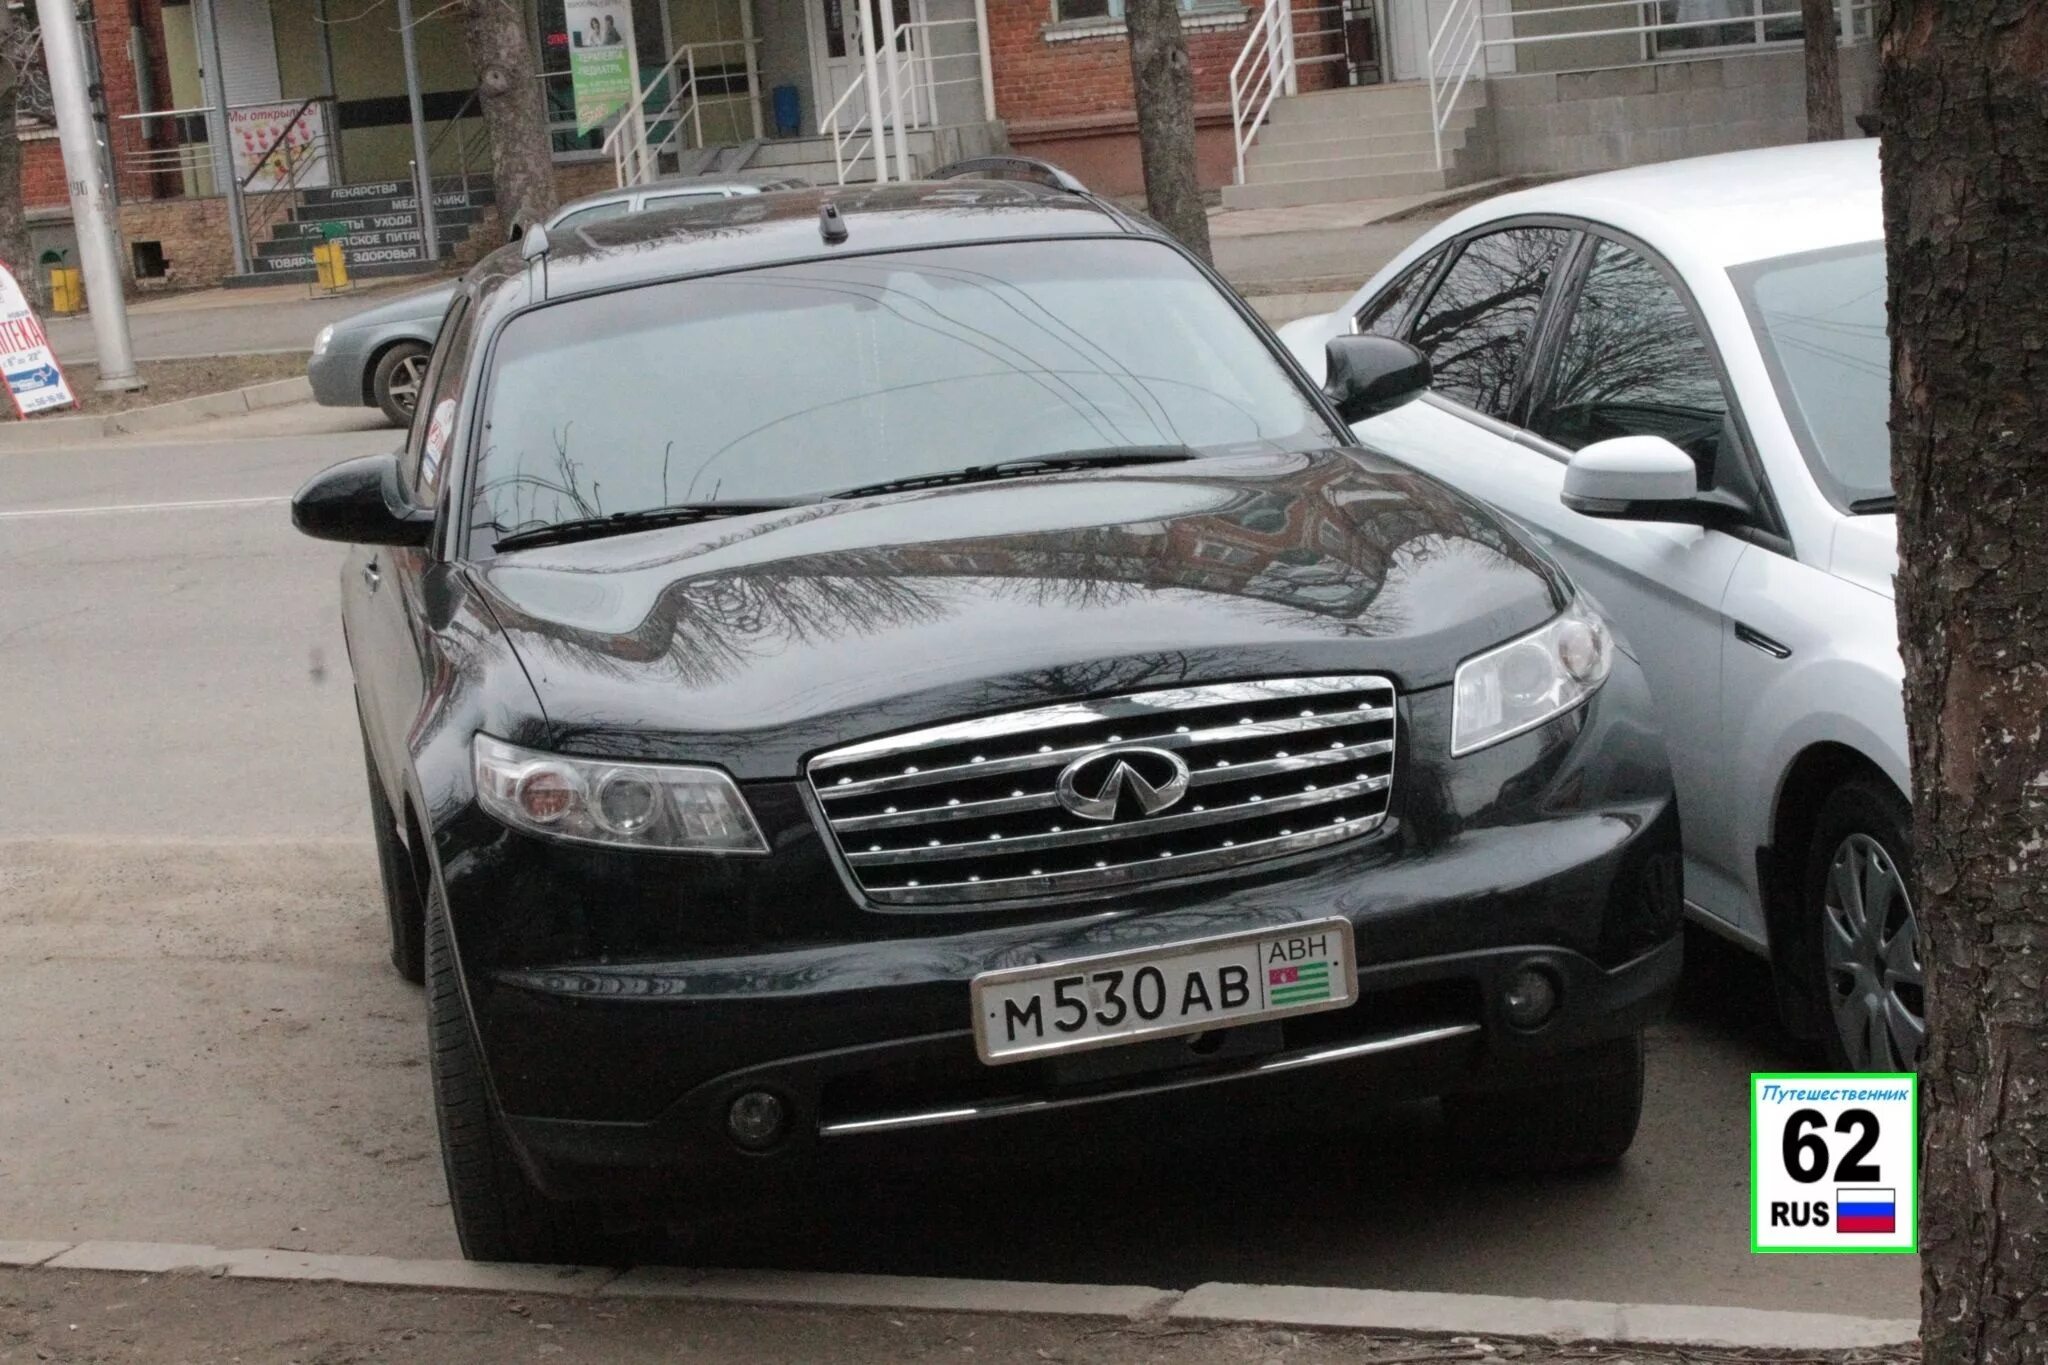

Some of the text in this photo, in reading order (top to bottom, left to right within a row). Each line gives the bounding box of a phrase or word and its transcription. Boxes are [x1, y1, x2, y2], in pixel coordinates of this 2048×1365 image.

[229, 103, 318, 122] Мы открылсь!
[331, 183, 398, 199] ЛЕКАРСТВА
[374, 215, 412, 229] УХОДА
[352, 247, 417, 264] ЗДОРОВЬЯ
[1267, 935, 1328, 964] ABH
